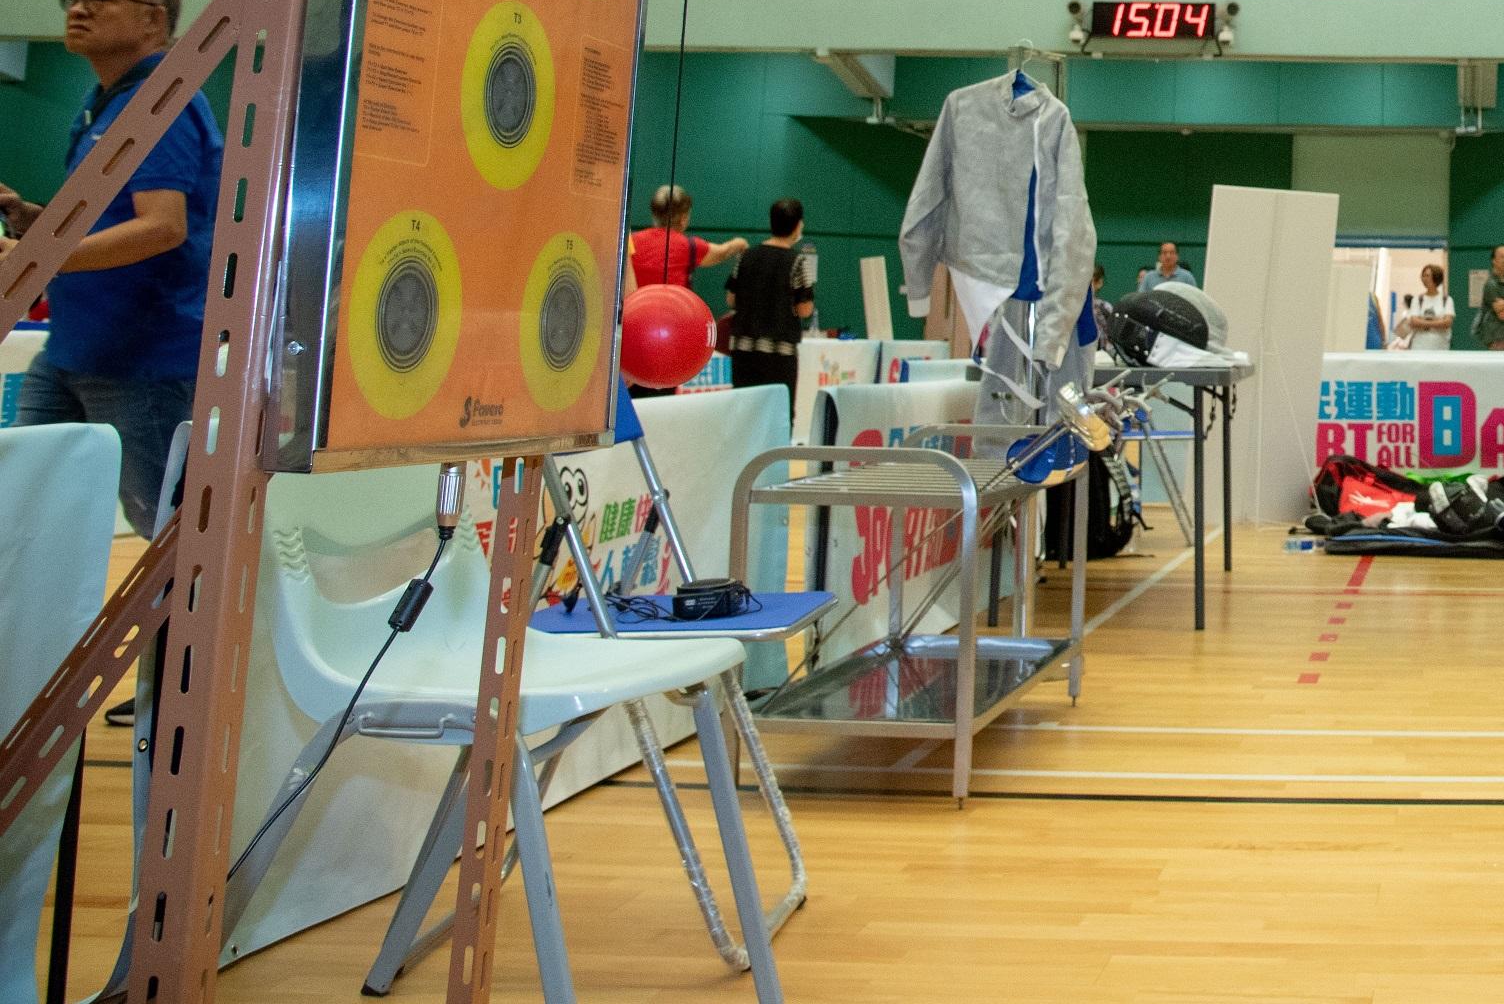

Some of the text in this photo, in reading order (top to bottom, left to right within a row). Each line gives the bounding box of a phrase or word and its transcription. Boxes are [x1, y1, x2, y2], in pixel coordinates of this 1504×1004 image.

[411, 219, 421, 232] T4
[1376, 423, 1415, 444] FOR
[1376, 445, 1416, 469] ALL
